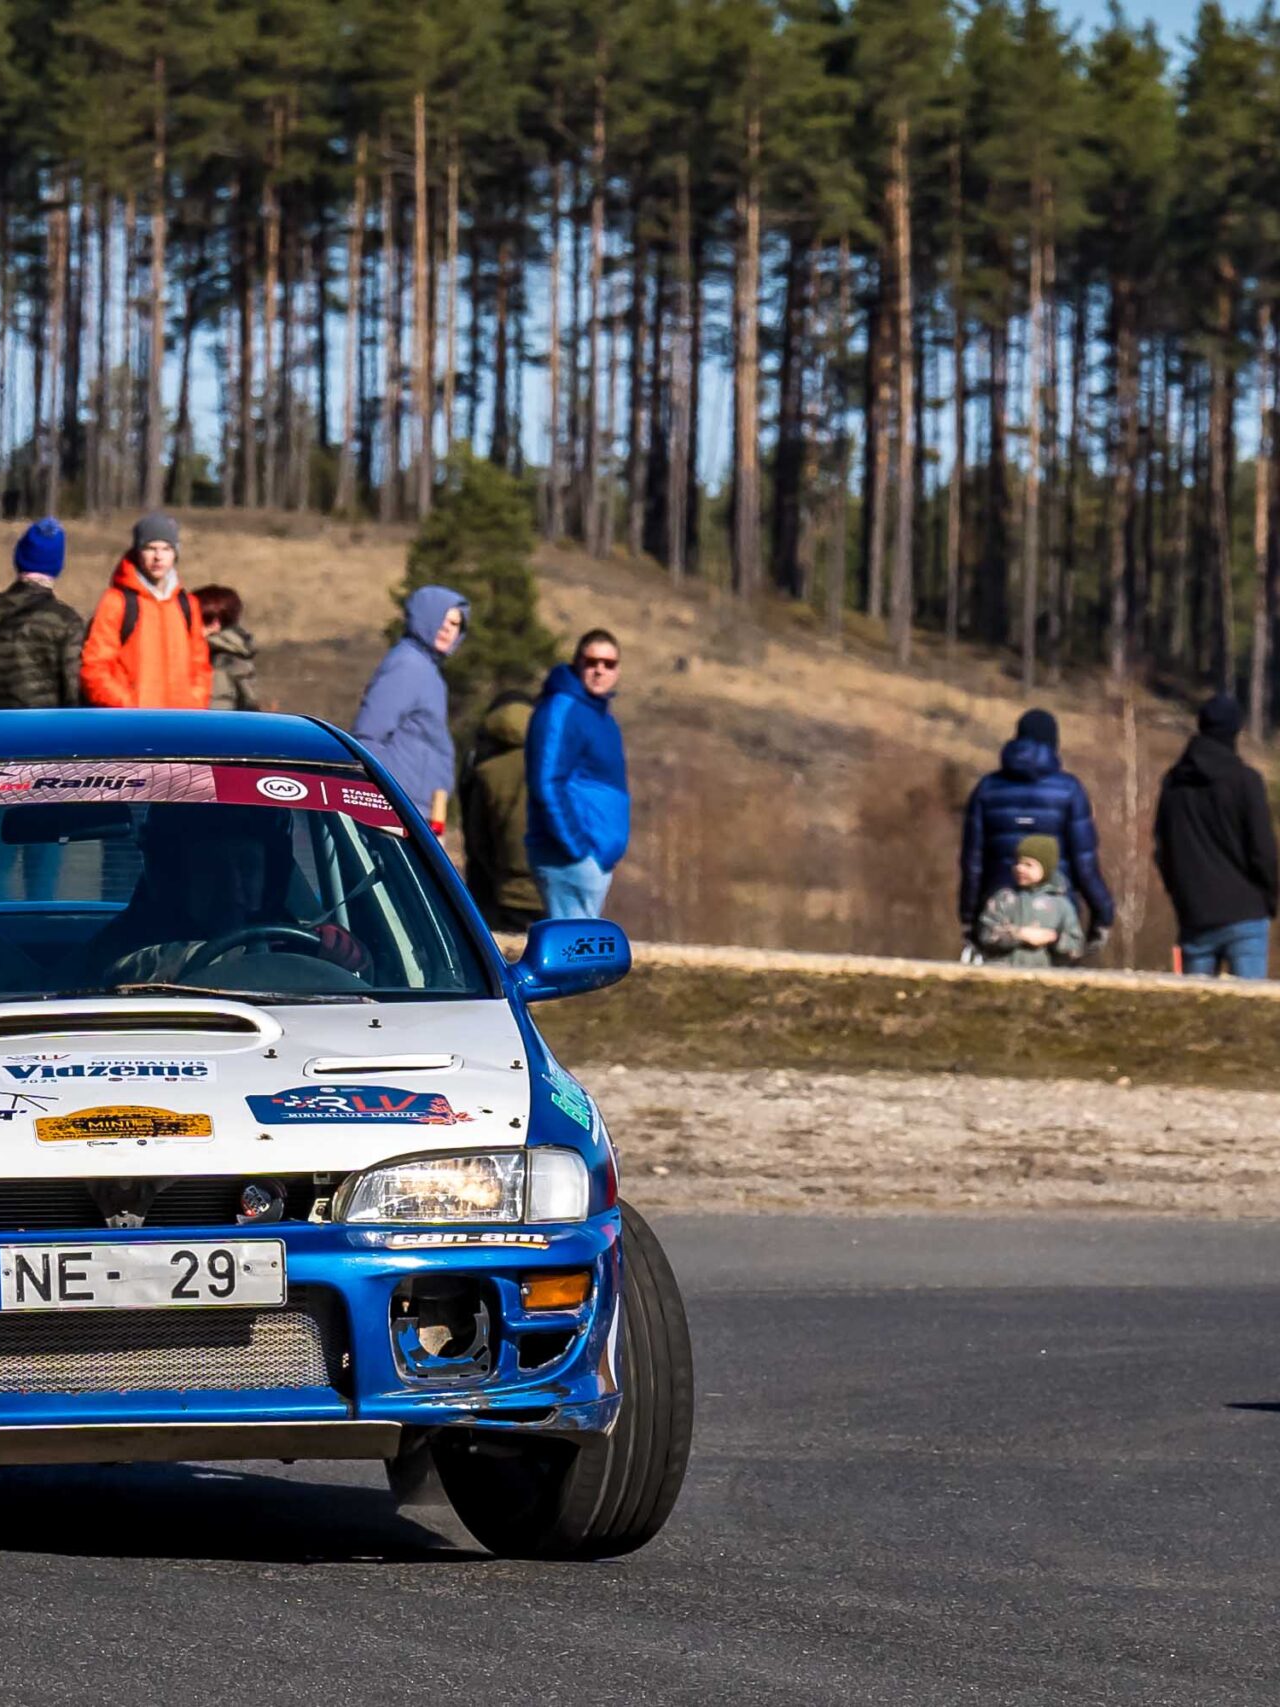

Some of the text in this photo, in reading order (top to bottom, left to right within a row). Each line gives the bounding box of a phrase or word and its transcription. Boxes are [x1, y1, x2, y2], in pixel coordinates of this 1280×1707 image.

[2, 1064, 208, 1079] Vidzeme
[88, 1120, 130, 1128] MINI
[392, 1232, 546, 1245] can-am
[170, 1249, 236, 1299] 29
